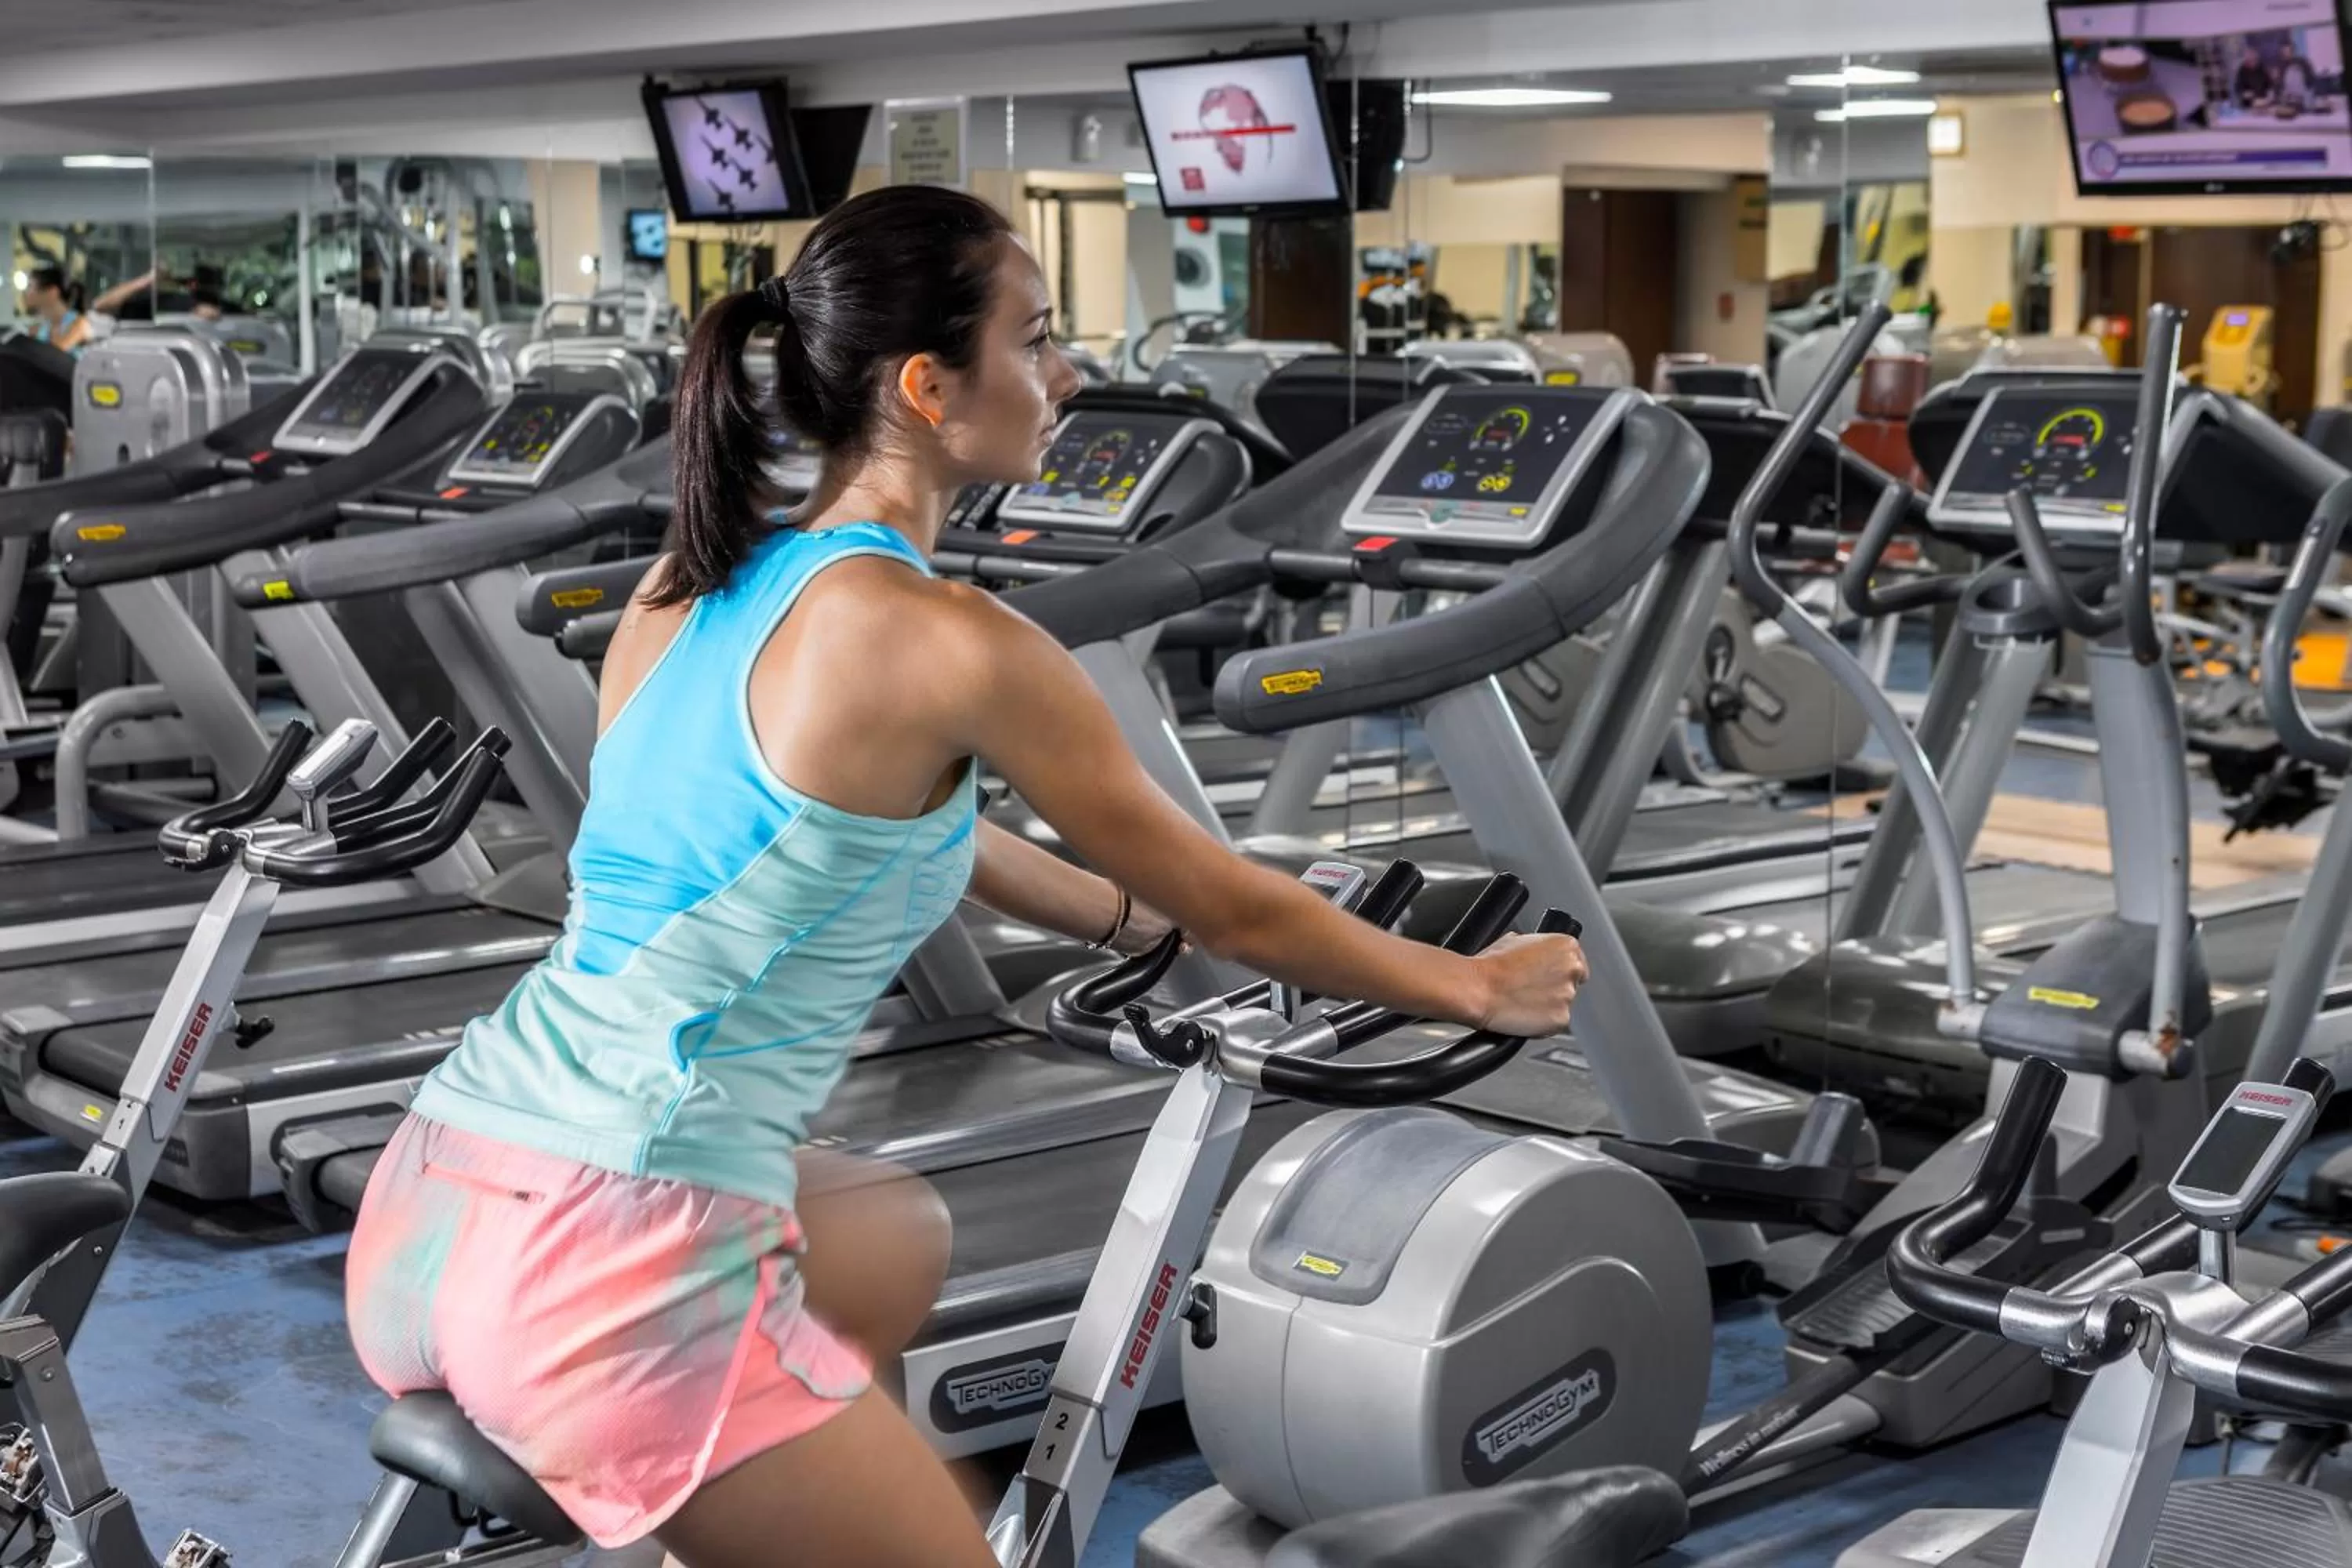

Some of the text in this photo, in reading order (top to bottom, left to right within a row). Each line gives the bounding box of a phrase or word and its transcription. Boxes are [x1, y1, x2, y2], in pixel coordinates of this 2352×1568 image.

[164, 1003, 213, 1092] KEISER
[2238, 1091, 2293, 1105] KEISER
[1120, 1261, 1178, 1390] KEISER
[1054, 1412, 1069, 1430] 2
[1480, 1377, 1595, 1454] TECHNOGYM
[1045, 1443, 1055, 1461] 1
